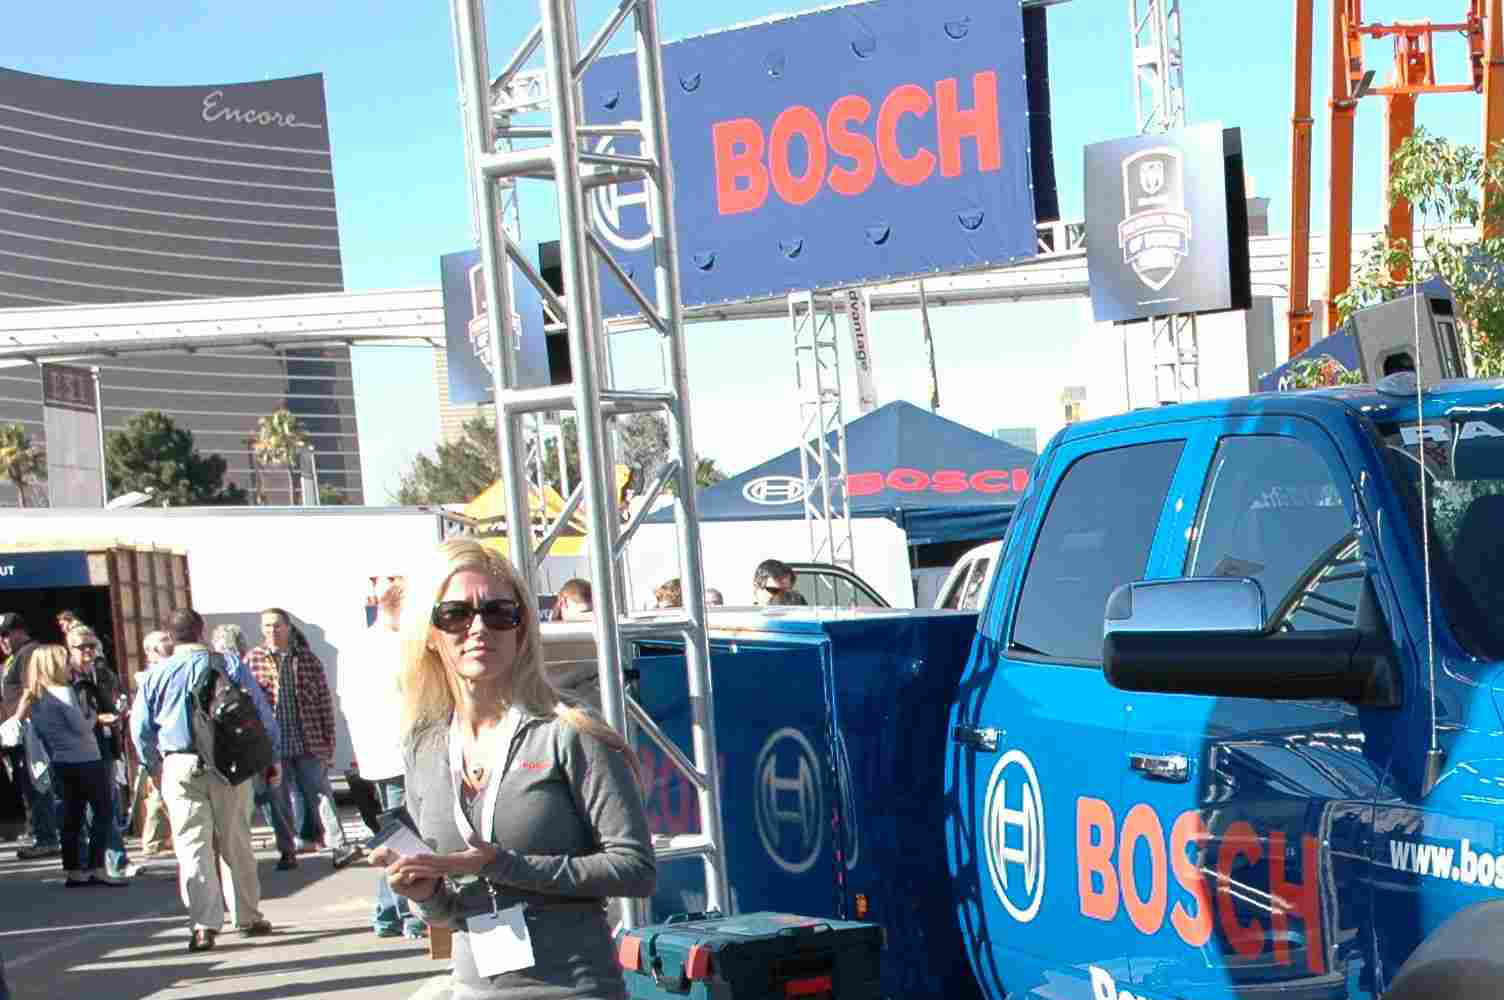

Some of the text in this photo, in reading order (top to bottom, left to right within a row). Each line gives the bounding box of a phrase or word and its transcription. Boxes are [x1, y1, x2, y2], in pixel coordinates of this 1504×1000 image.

[202, 89, 320, 128] Encore
[712, 70, 1001, 215] BOSCH
[849, 290, 869, 372] dvantage
[1077, 796, 1326, 974] BOSCH
